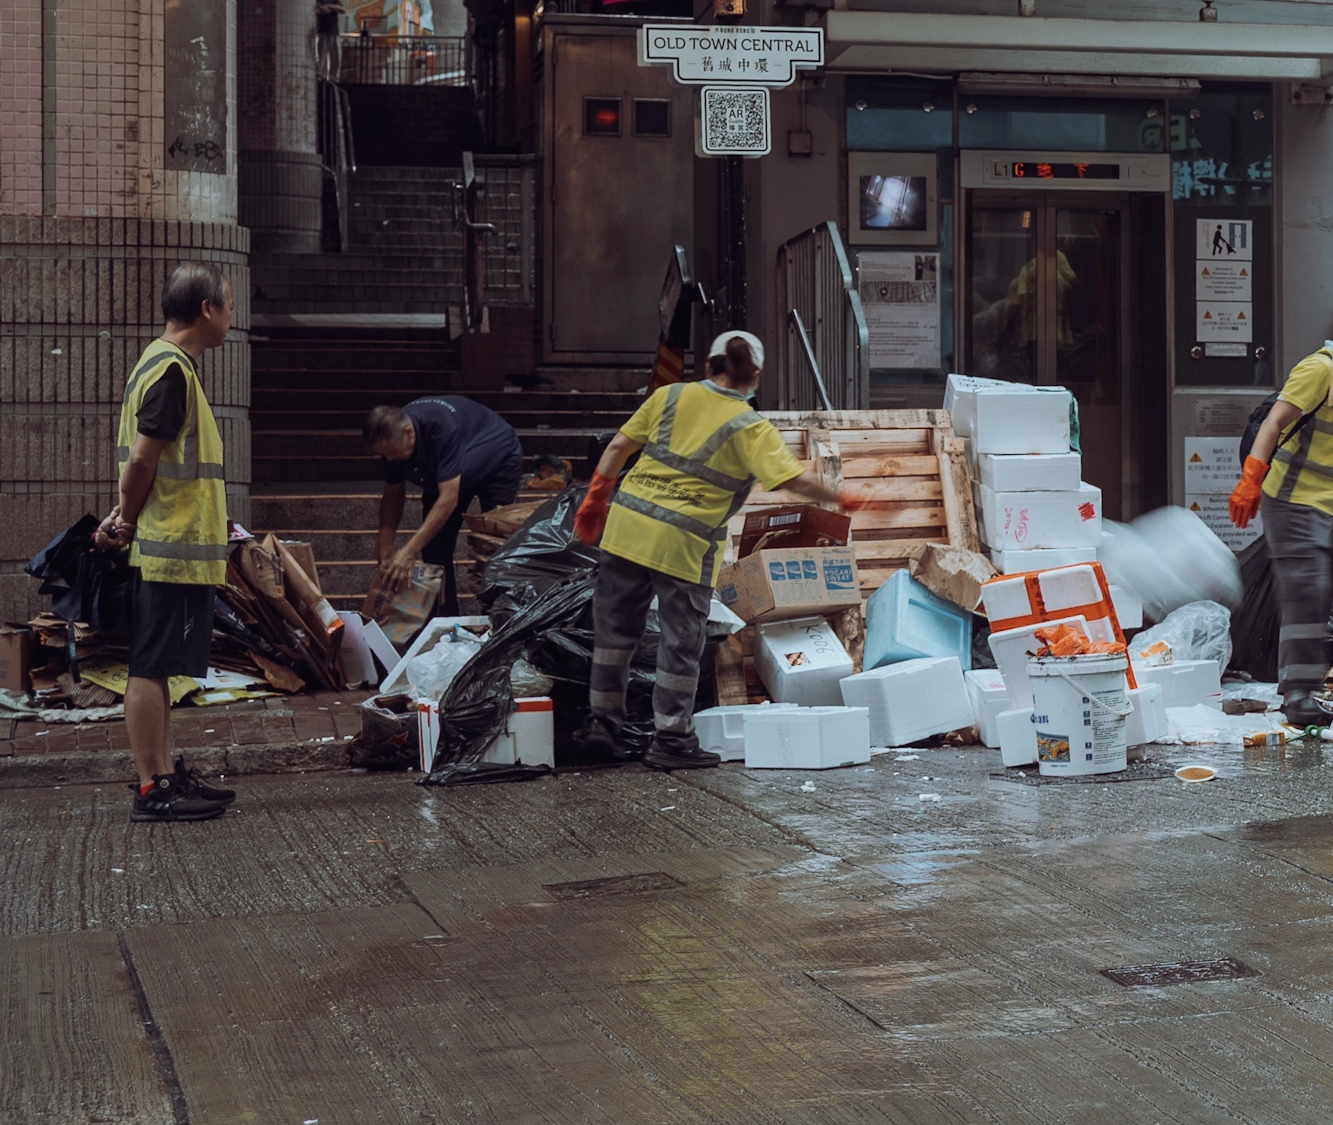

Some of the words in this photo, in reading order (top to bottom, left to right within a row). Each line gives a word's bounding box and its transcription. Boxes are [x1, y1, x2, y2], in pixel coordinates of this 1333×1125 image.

[653, 37, 686, 49] OLD
[688, 37, 738, 51] TOWN
[741, 39, 814, 53] CENTRAL
[701, 55, 770, 73] 舊城中環
[728, 108, 744, 119] AR
[993, 162, 1008, 176] L1
[1014, 162, 1025, 177] G
